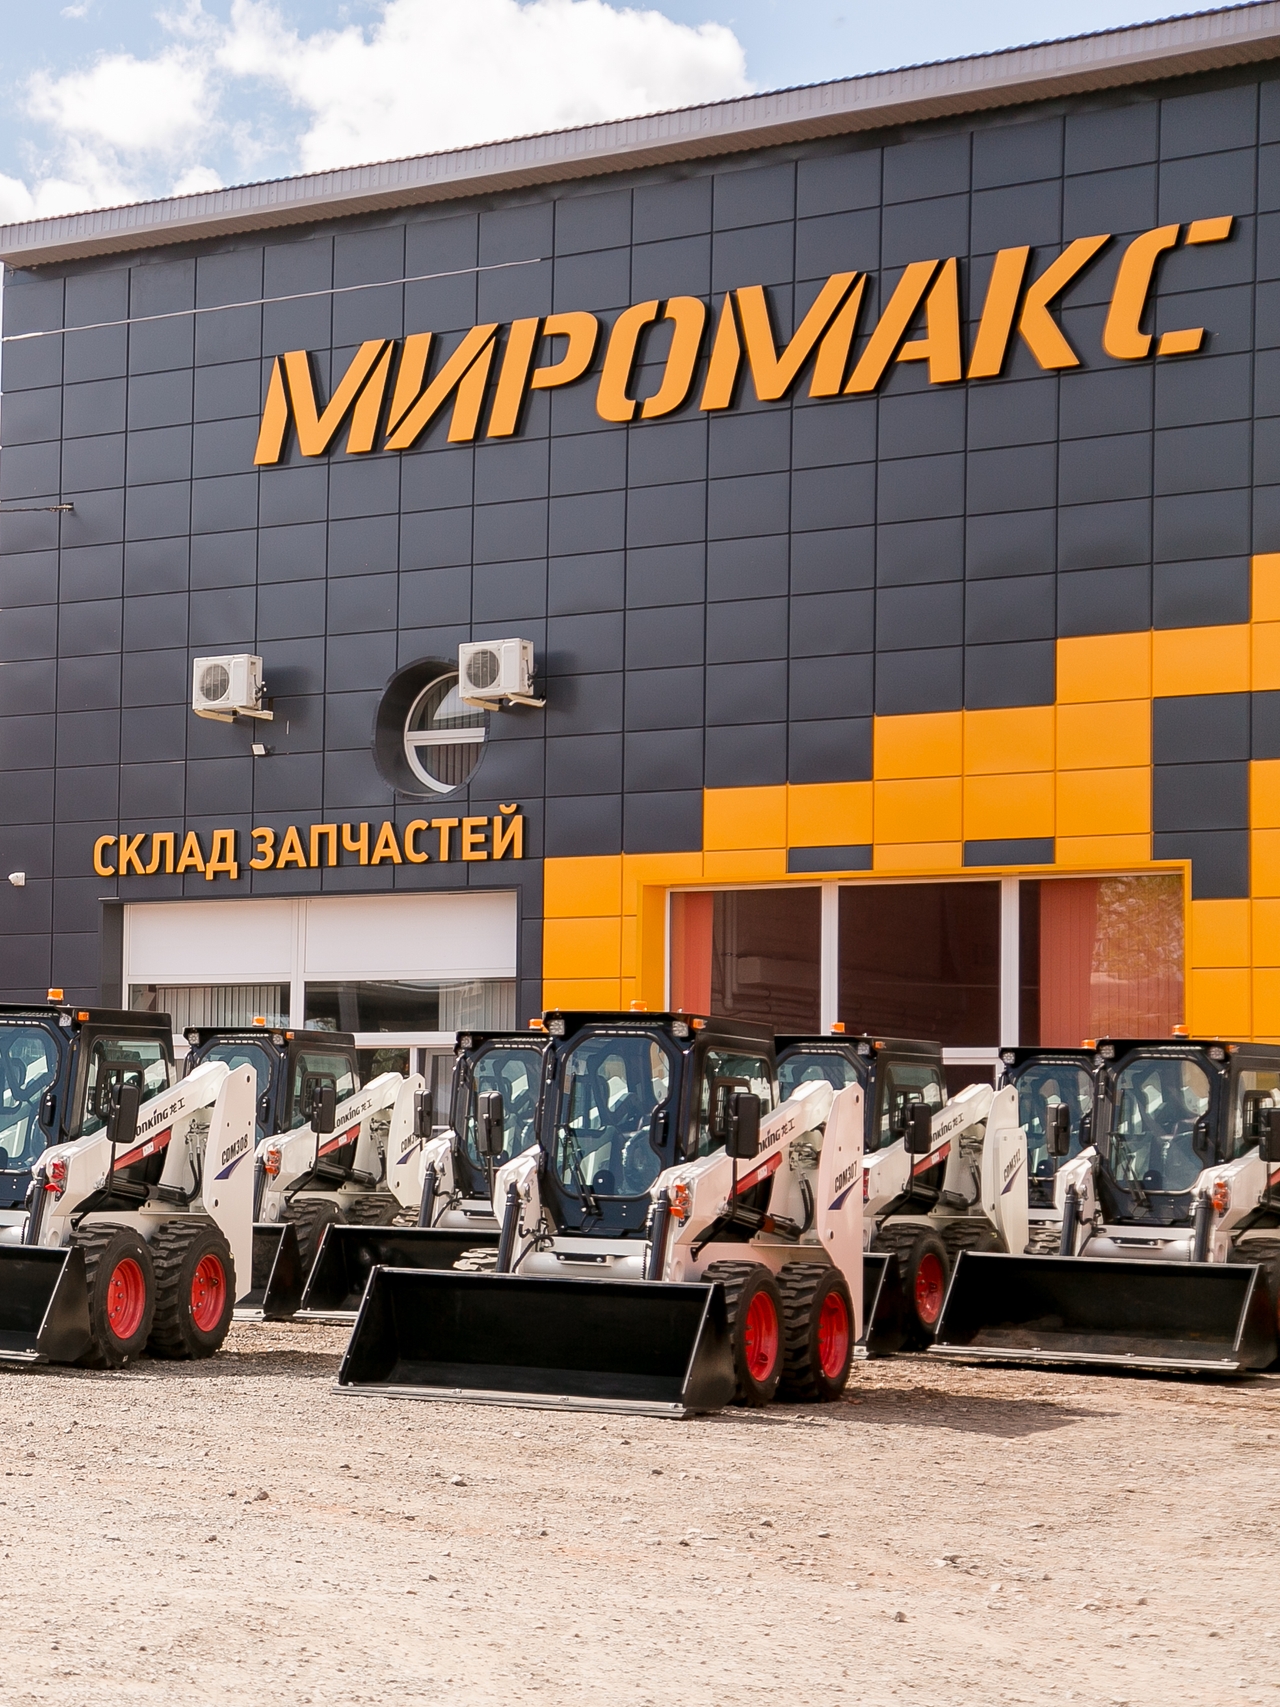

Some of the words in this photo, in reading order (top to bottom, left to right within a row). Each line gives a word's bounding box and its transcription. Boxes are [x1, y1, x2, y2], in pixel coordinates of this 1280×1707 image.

[253, 215, 1233, 466] МИРОМАКС
[93, 829, 238, 881] СКЛАД
[248, 803, 524, 870] ЗАПЧАСТЕЙ
[135, 1108, 169, 1137] ONKING
[335, 1106, 361, 1128] ONKING
[932, 1121, 952, 1143] NKING
